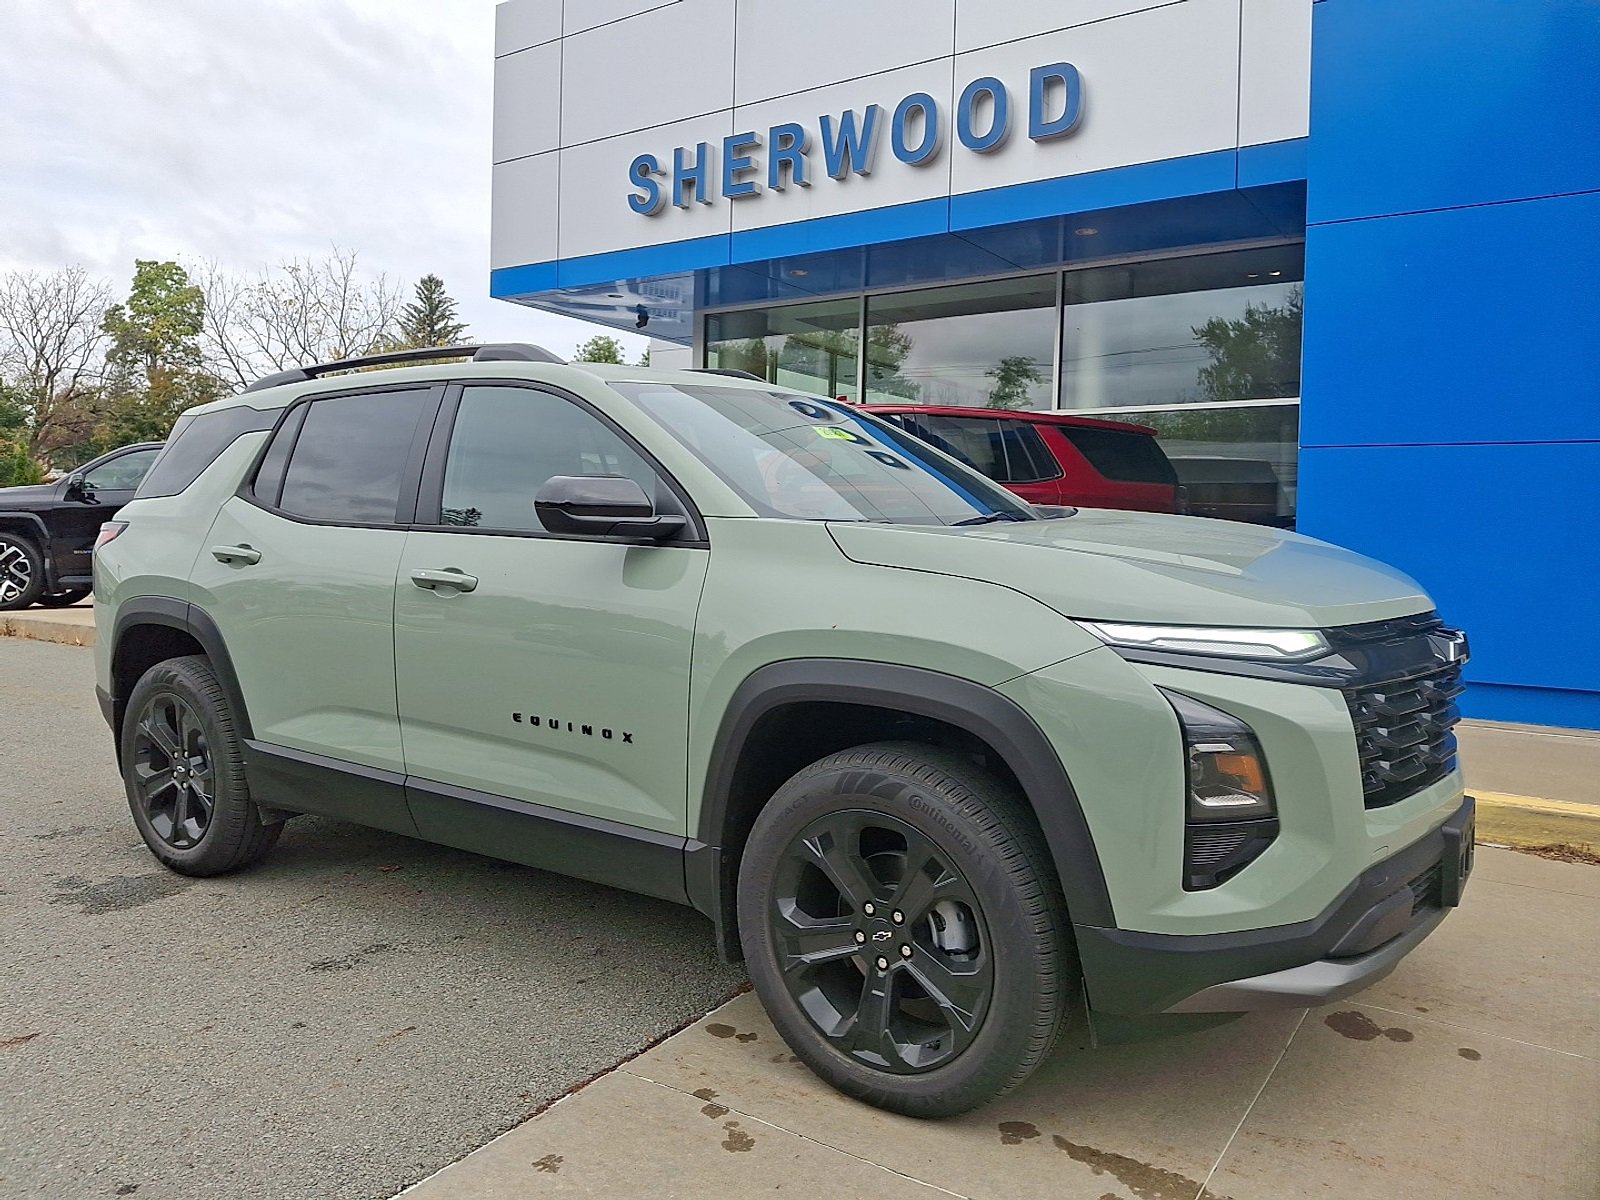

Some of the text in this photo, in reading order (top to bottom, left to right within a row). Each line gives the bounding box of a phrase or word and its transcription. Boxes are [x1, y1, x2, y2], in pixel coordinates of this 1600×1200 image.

[627, 61, 1086, 216] SHERWOOD
[512, 712, 633, 744] EQUINOX
[908, 794, 977, 855] Continental
